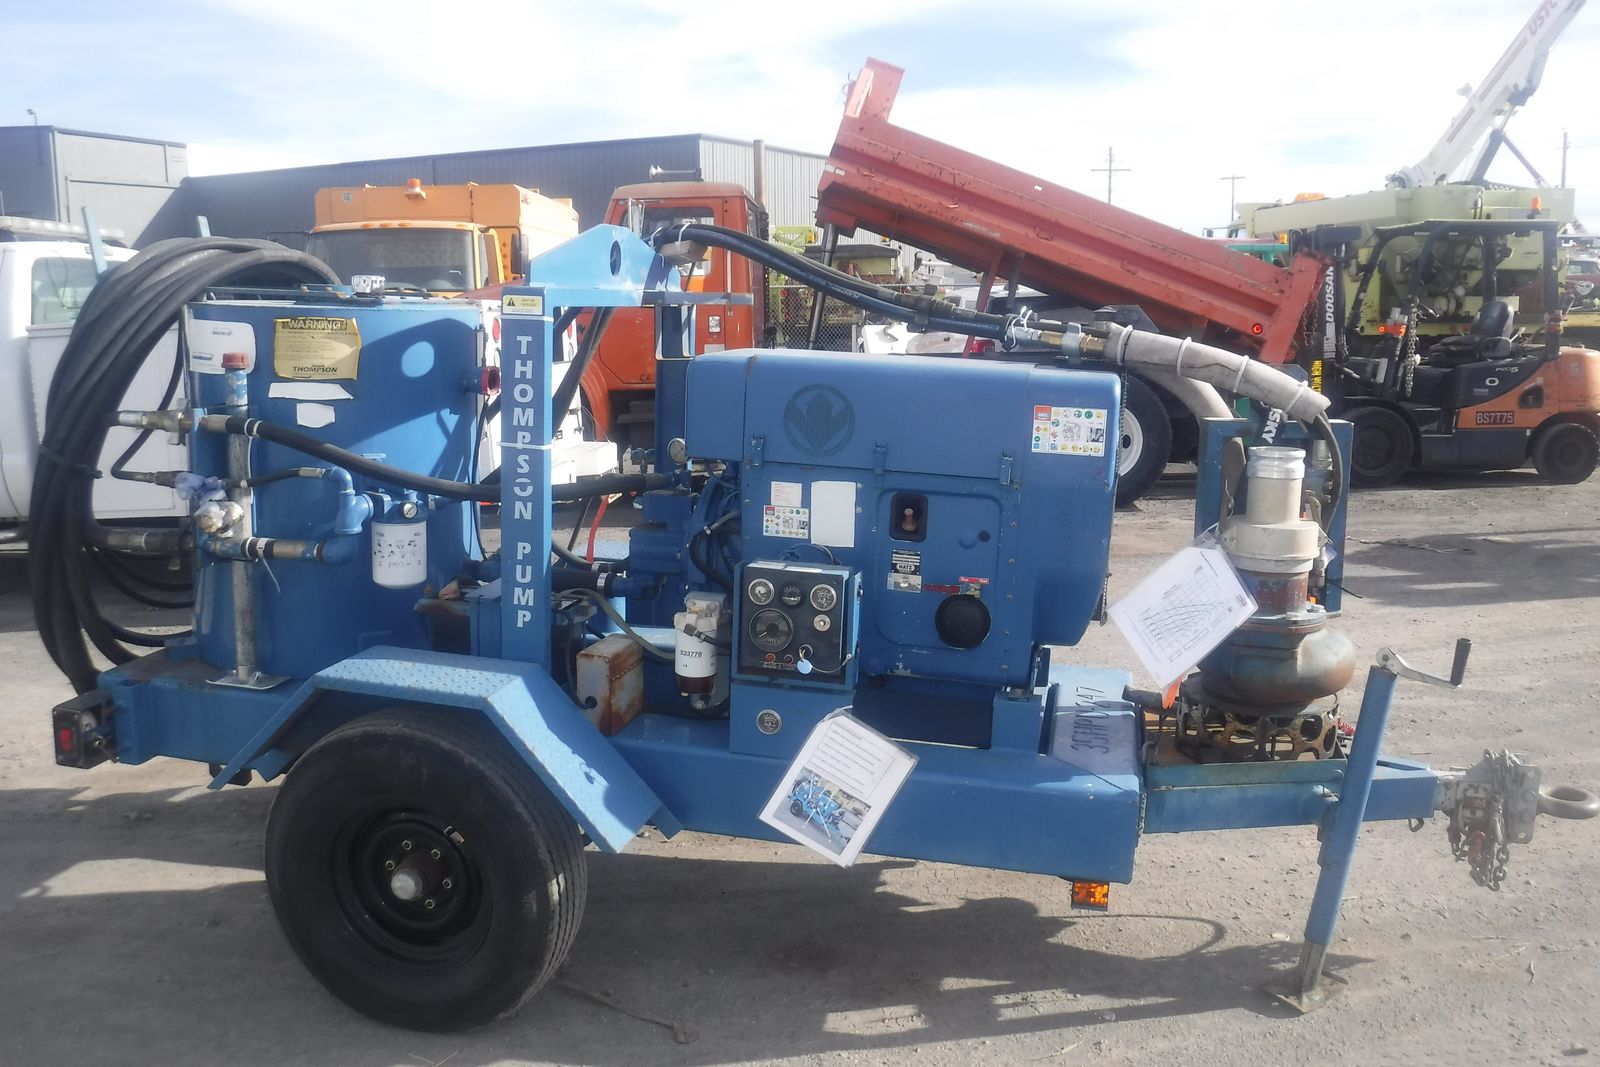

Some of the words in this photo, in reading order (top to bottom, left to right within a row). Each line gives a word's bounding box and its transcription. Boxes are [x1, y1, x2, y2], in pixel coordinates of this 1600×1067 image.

[289, 319, 342, 331] WARNING
[513, 335, 534, 520] THOMPSON
[514, 541, 534, 628] PUMP
